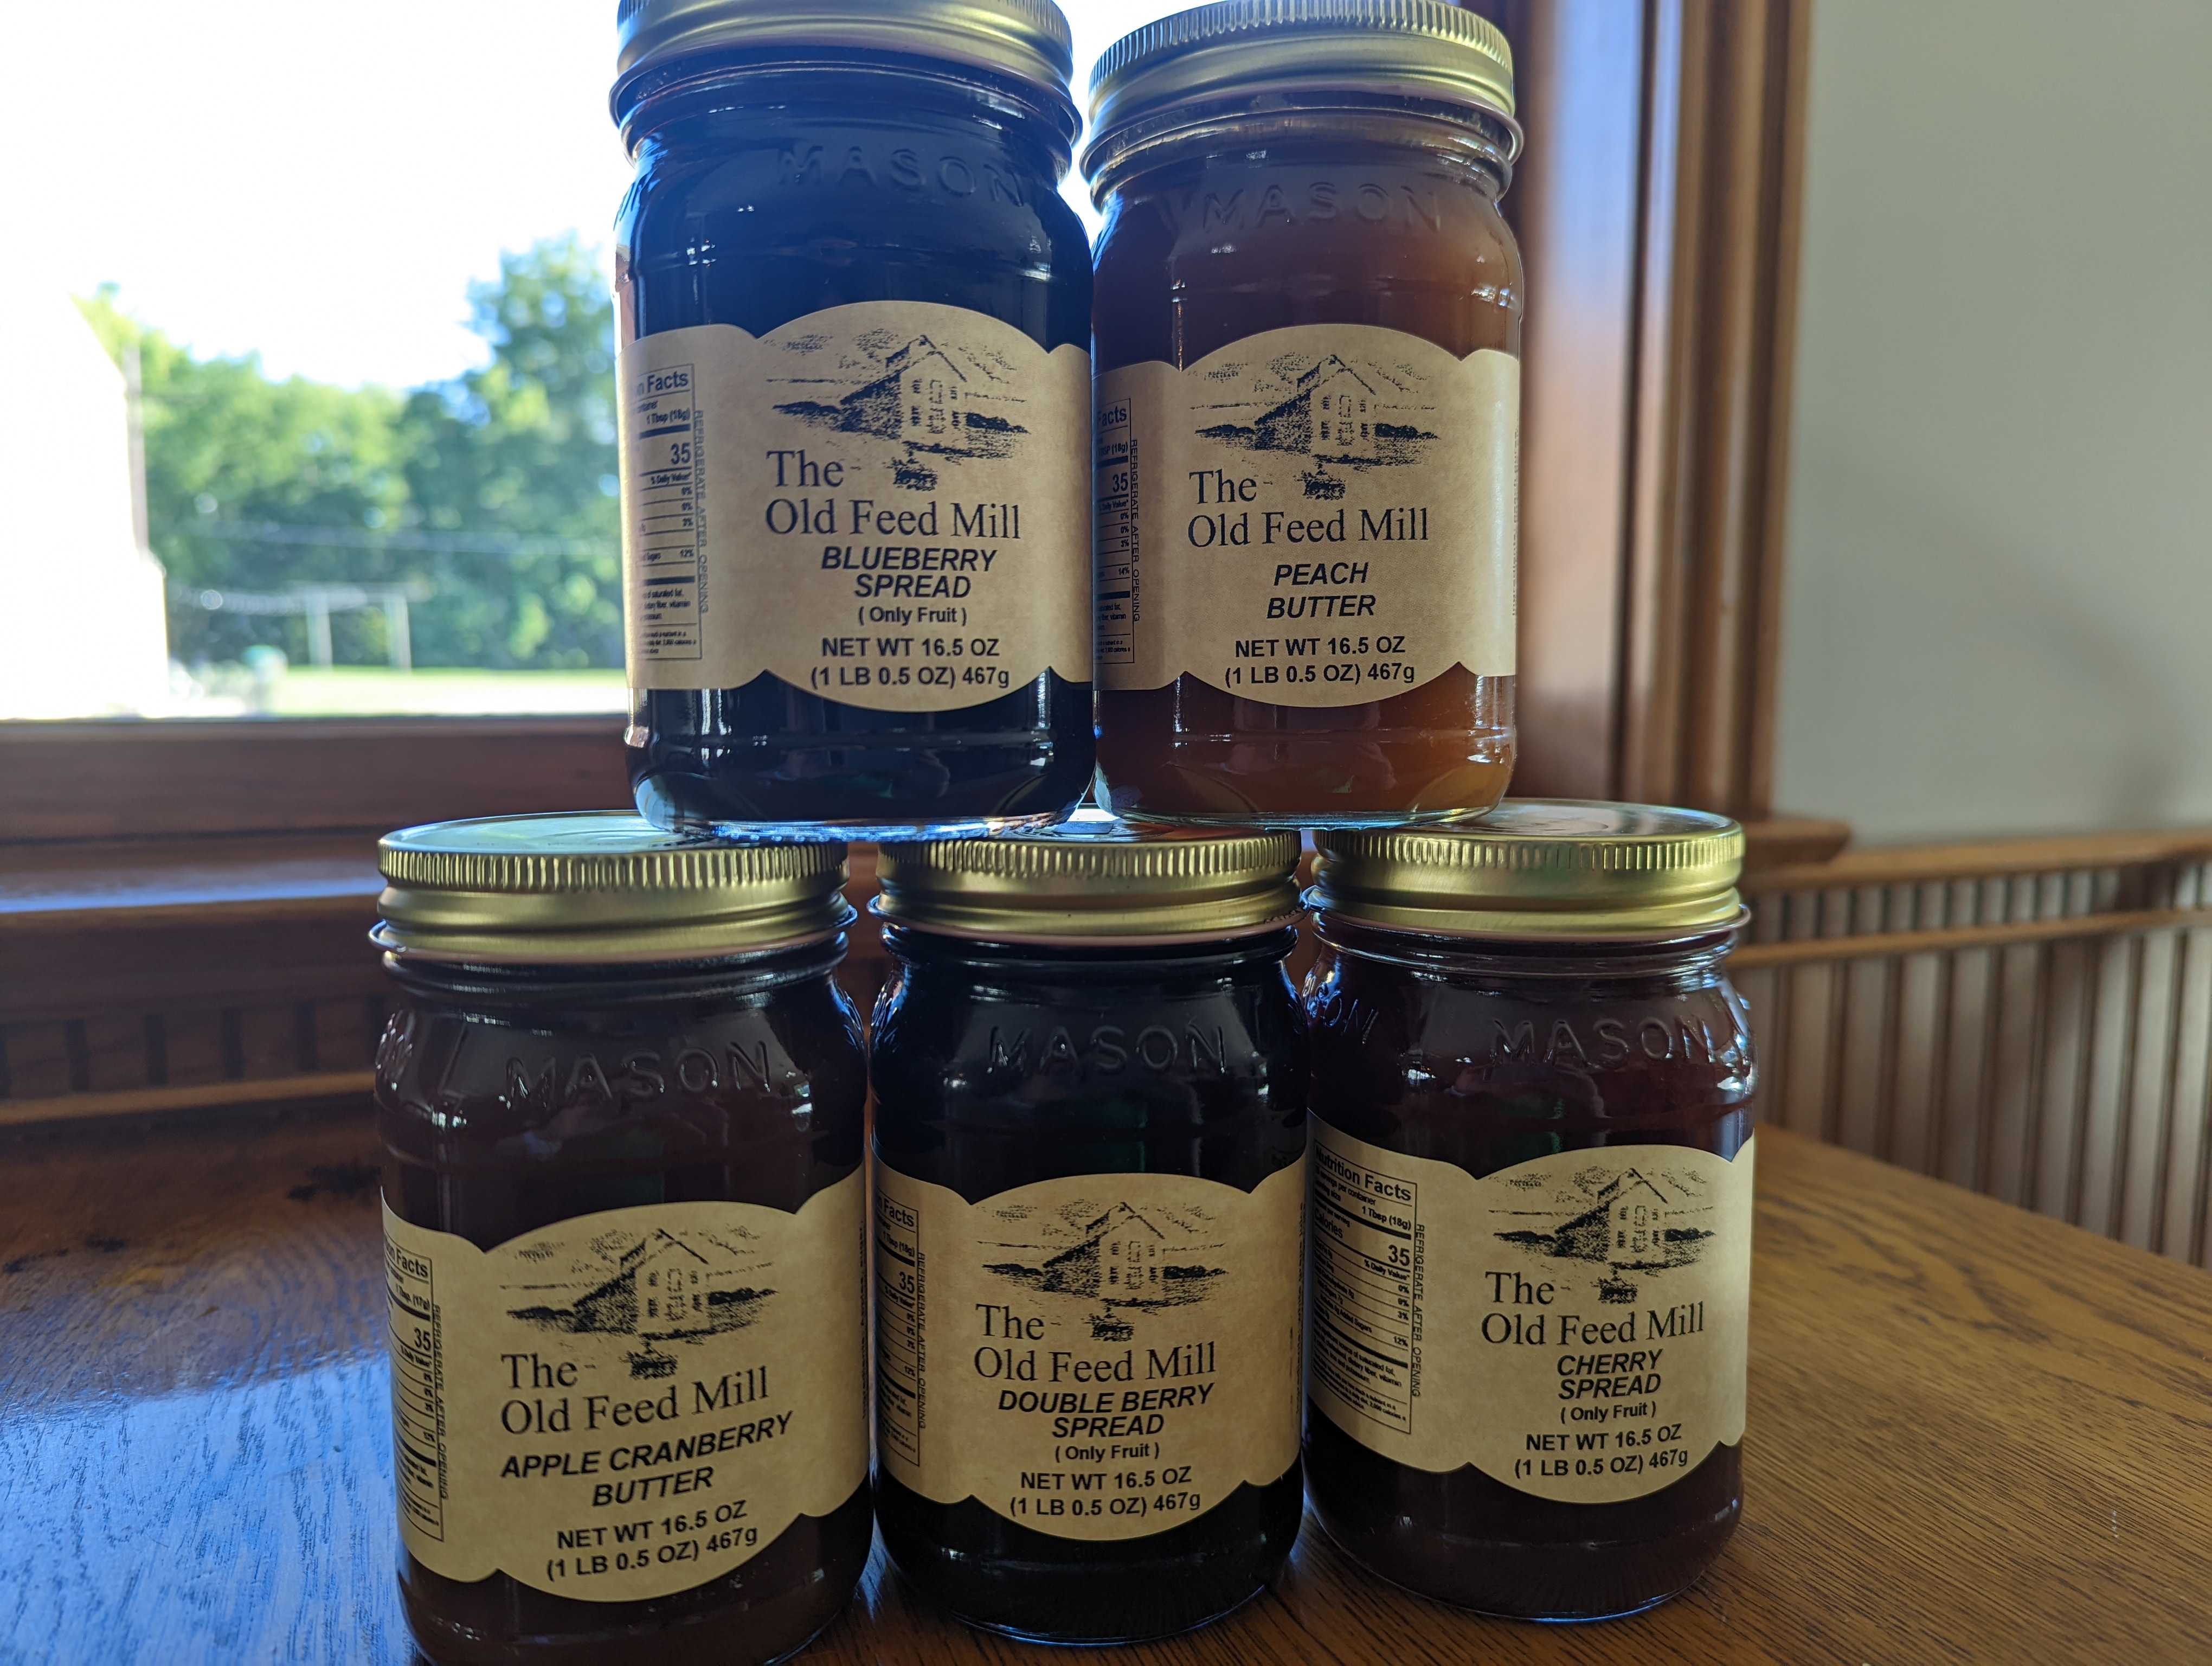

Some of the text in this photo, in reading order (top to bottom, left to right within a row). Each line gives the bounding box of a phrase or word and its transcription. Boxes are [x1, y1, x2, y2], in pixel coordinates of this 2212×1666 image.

[777, 145, 1025, 208] MASON
[1203, 182, 1442, 234] MASON
[647, 371, 689, 393] Facts
[1098, 406, 1127, 428] Facts
[670, 442, 691, 465] 35
[1112, 441, 1128, 456] (18g)
[766, 449, 844, 488] The
[1113, 472, 1128, 492] 35
[1189, 468, 1257, 505] The
[695, 410, 709, 613] REFRIGERATE AFTER OPENING
[766, 498, 1021, 539] Old Feed Mill
[1188, 507, 1429, 548] Old Feed Mill
[820, 546, 998, 572] BLUEBERRY
[1118, 567, 1130, 575] 14%
[853, 573, 971, 598] SPREAD
[1274, 562, 1369, 586] PEACH
[869, 606, 913, 626] Only
[917, 606, 957, 623] Fruit
[1266, 594, 1376, 619] BUTTER
[822, 637, 1000, 657] NET WT 16.5 OZ
[1235, 636, 1406, 658] NET WT 16.5 OZ
[811, 666, 1009, 690] (1 LB 0.5 OZ) 467g
[1225, 662, 1414, 689] (1 LB 0.5 OZ) 467g
[987, 1024, 1227, 1074] MASON
[1490, 1018, 1715, 1064] MASON
[506, 1041, 771, 1109] MASON
[1316, 1145, 1411, 1201] Nutrition Facts
[1320, 1171, 1376, 1206] servings per container
[884, 1198, 914, 1227] Facts
[1315, 1207, 1343, 1239] Calories
[1330, 1190, 1411, 1231] size 1 Tbsp (18g)
[396, 1247, 428, 1278] Facts
[899, 1243, 915, 1257] (18g)
[1388, 1244, 1410, 1266] 35
[1364, 1259, 1369, 1267] %
[1371, 1263, 1386, 1275] Daily
[899, 1272, 915, 1294] 35
[1485, 1271, 1555, 1305] The
[413, 1293, 430, 1311] (17g)
[1397, 1311, 1409, 1321] 3%
[1412, 1223, 1424, 1398] REFRIGERATE AFTER OPENING
[975, 1303, 1046, 1341] The
[1340, 1309, 1354, 1323] Added
[1354, 1318, 1372, 1333] Sugars
[1481, 1301, 1703, 1345] Old Feed Mill
[414, 1327, 432, 1351] 35
[1393, 1336, 1409, 1347] 12%
[500, 1353, 577, 1389] The
[974, 1341, 1216, 1383] Old Feed Mill
[1348, 1356, 1401, 1387] dietary fiber, vitamin
[1359, 1354, 1396, 1377] saturated fat,
[1557, 1348, 1663, 1376] CHERRY
[501, 1366, 770, 1434] Old Feed Mill
[998, 1382, 1216, 1413] DOUBLE BERRY
[1558, 1373, 1661, 1400] SPREAD
[434, 1304, 449, 1500] REFRIGERATE AFTER OPENING
[1570, 1406, 1609, 1423] Only
[1613, 1402, 1648, 1419] Fruit
[1052, 1413, 1165, 1438] SPREAD
[1526, 1423, 1682, 1451] NET WT 16.5 OZ
[500, 1411, 793, 1478] APPLE CRANBERRY
[1065, 1445, 1106, 1463] Only
[1111, 1443, 1150, 1459] Fruit
[1021, 1465, 1192, 1490] NET WT 16.5 OZ
[1514, 1448, 1688, 1479] (1 LB 0.5 OZ) 467g
[591, 1466, 714, 1507] BUTTER
[1010, 1491, 1200, 1517] (1 LB 0.5 OZ) 467g
[557, 1500, 748, 1549] NET WT 16.5 OZ
[546, 1527, 757, 1582] (1 LB 0.5 OZ) 467g
